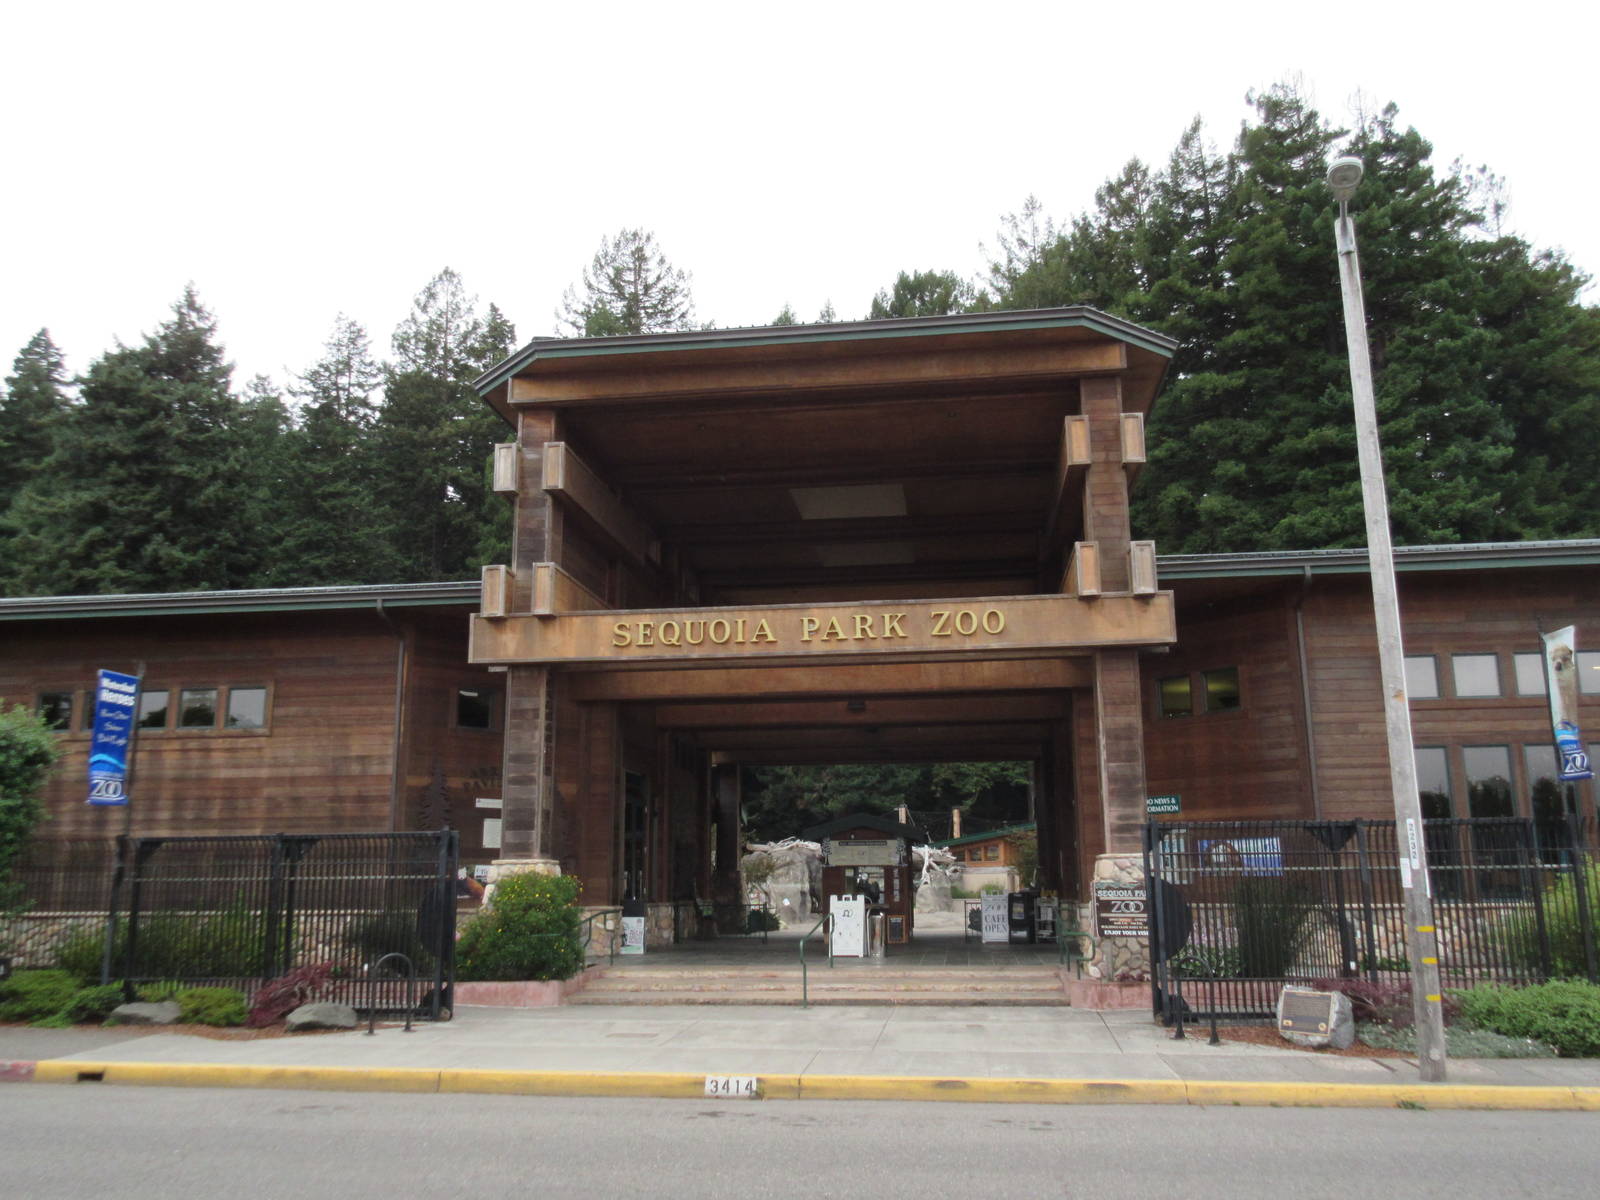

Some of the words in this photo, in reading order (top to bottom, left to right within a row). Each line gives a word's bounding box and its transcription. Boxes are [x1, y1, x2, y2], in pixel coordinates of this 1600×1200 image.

[611, 617, 778, 648] SEQUOIA
[799, 612, 908, 642] PARK
[930, 608, 1006, 637] ZOO
[91, 779, 122, 798] ZOO
[1154, 797, 1170, 805] NEWS
[1097, 889, 1132, 897] SEQUOIA
[1111, 900, 1144, 913] ZOO
[985, 924, 1008, 933] OPEN
[710, 1079, 753, 1094] 3414
